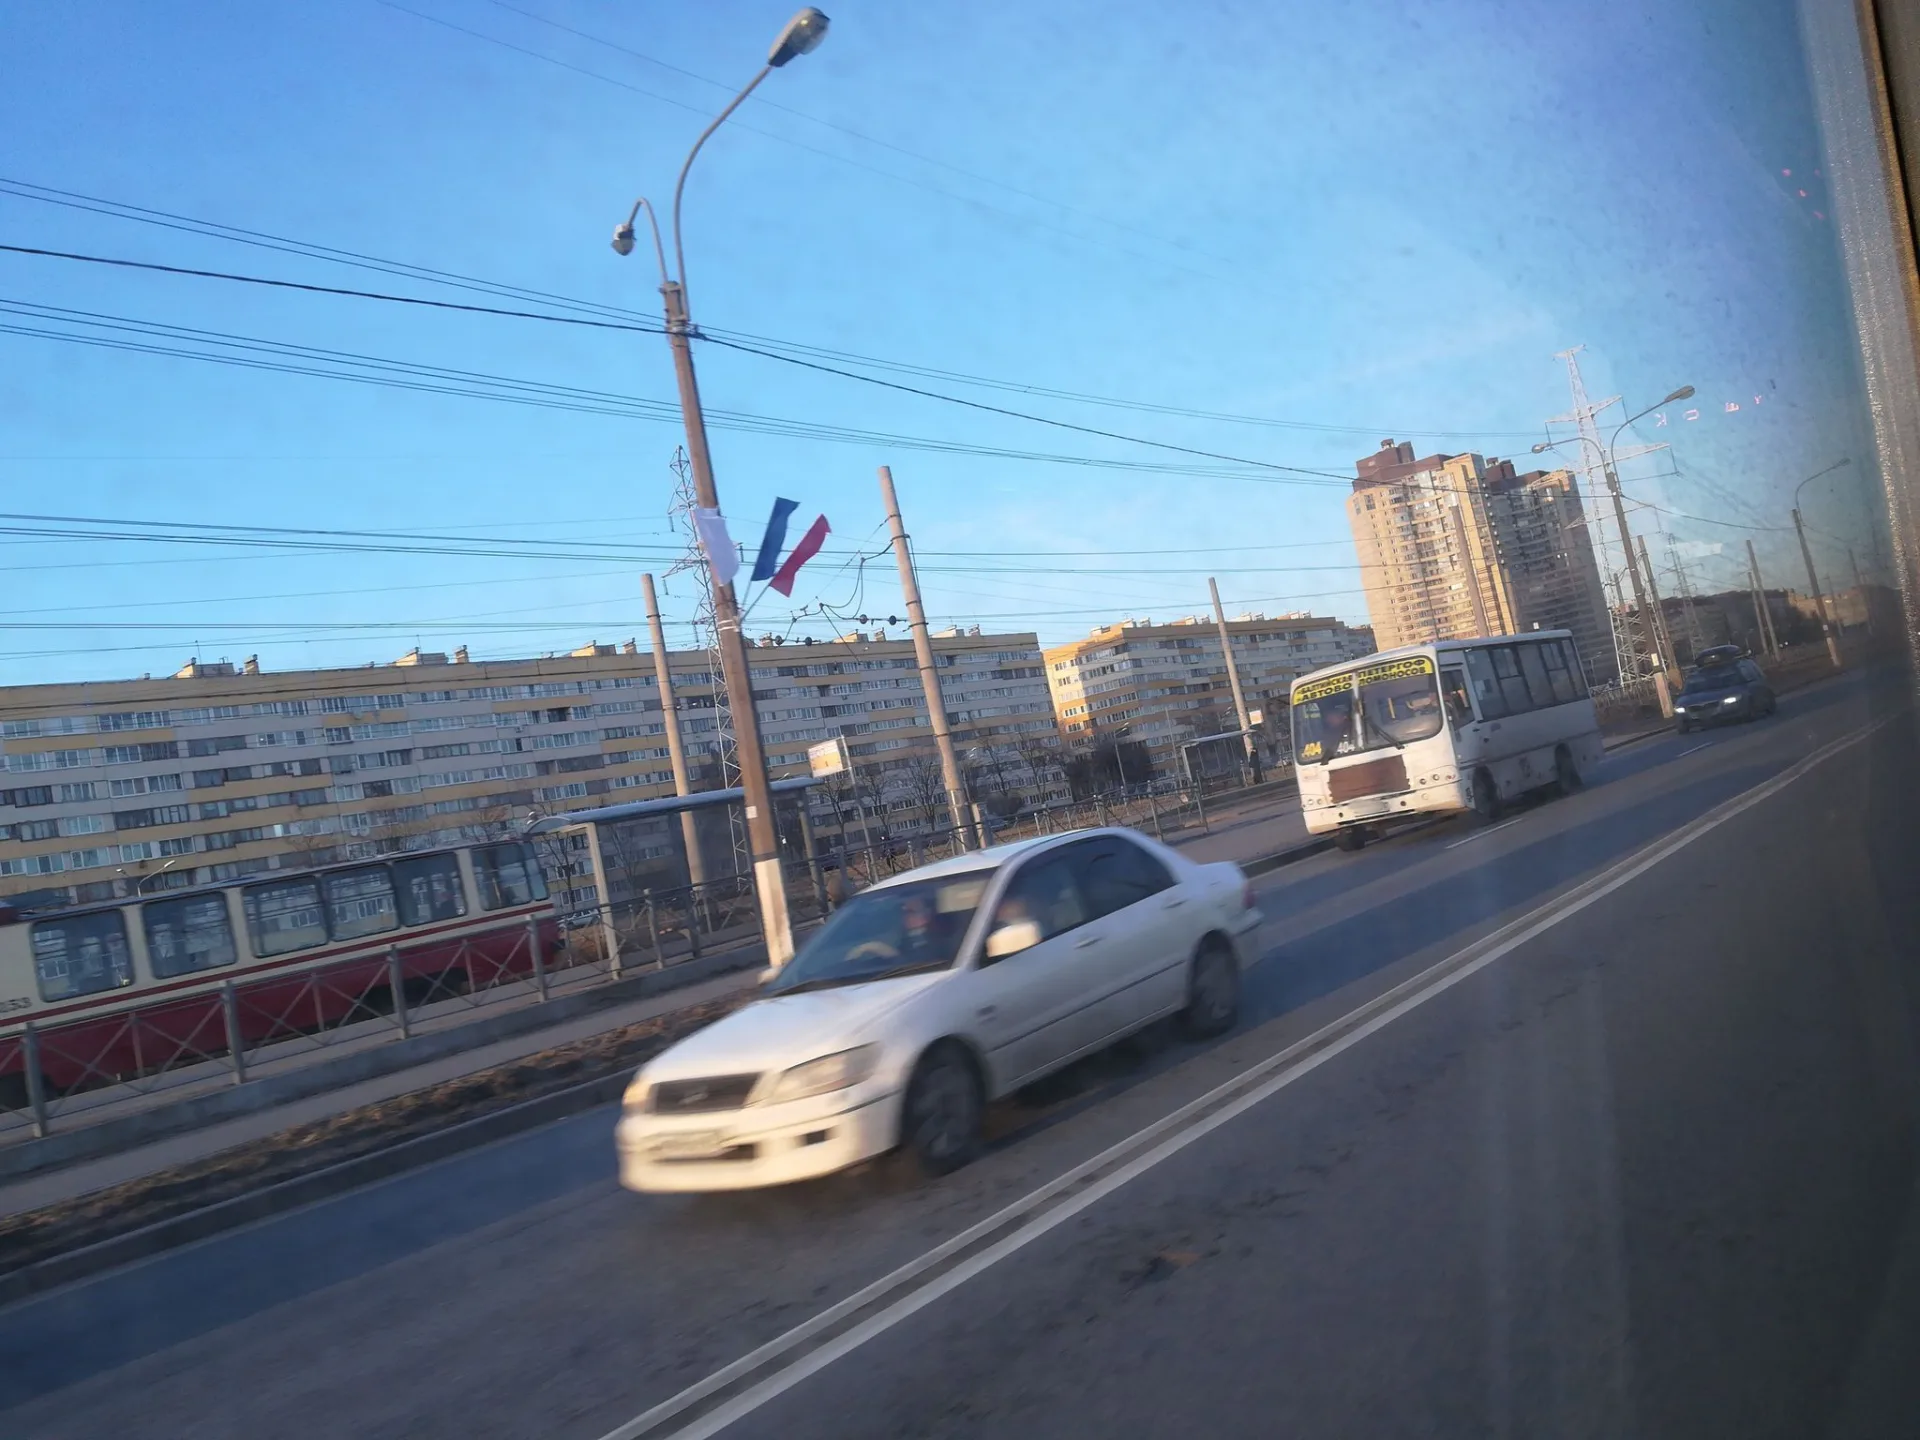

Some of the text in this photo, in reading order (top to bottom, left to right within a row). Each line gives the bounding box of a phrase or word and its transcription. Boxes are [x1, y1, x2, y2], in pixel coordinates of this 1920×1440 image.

[1358, 659, 1426, 678] ПЕТЕРГОФ
[1358, 667, 1426, 686] ЛОМОНОСОВ
[1302, 682, 1353, 701] АВТОВО
